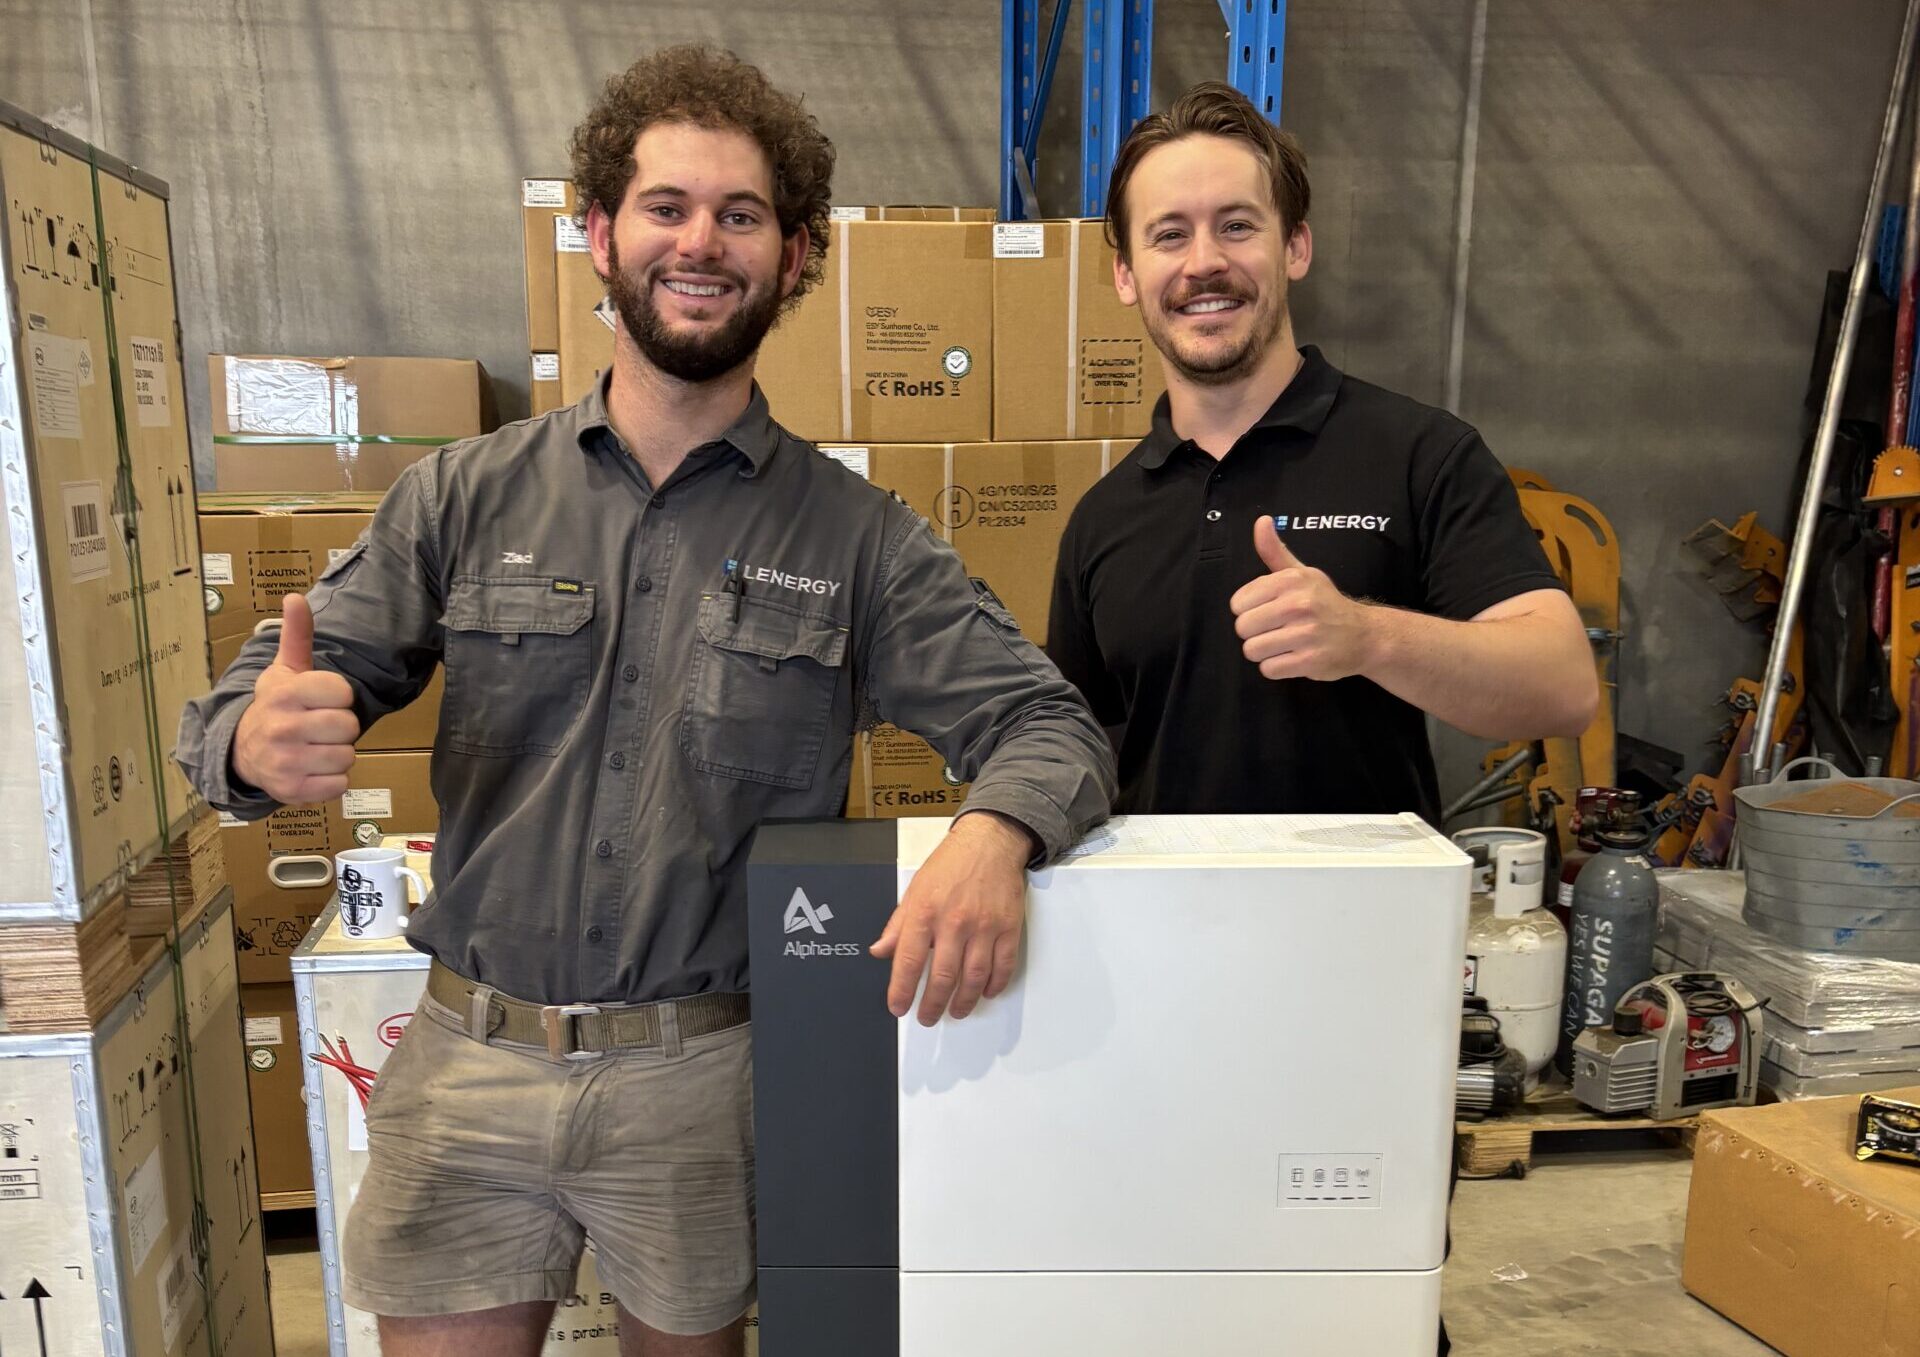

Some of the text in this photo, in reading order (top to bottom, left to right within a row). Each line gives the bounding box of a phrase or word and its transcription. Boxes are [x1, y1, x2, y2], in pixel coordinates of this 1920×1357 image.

[893, 381, 945, 397] RoHS
[978, 484, 1058, 497] 4G/Y60/S/25
[1291, 515, 1392, 532] LENERGY
[264, 568, 307, 577] CAUTION
[743, 564, 841, 597] LENERGY
[898, 790, 946, 806] RoHS
[280, 810, 320, 818] CAUTION
[1564, 913, 1589, 1039] YES WE CAN
